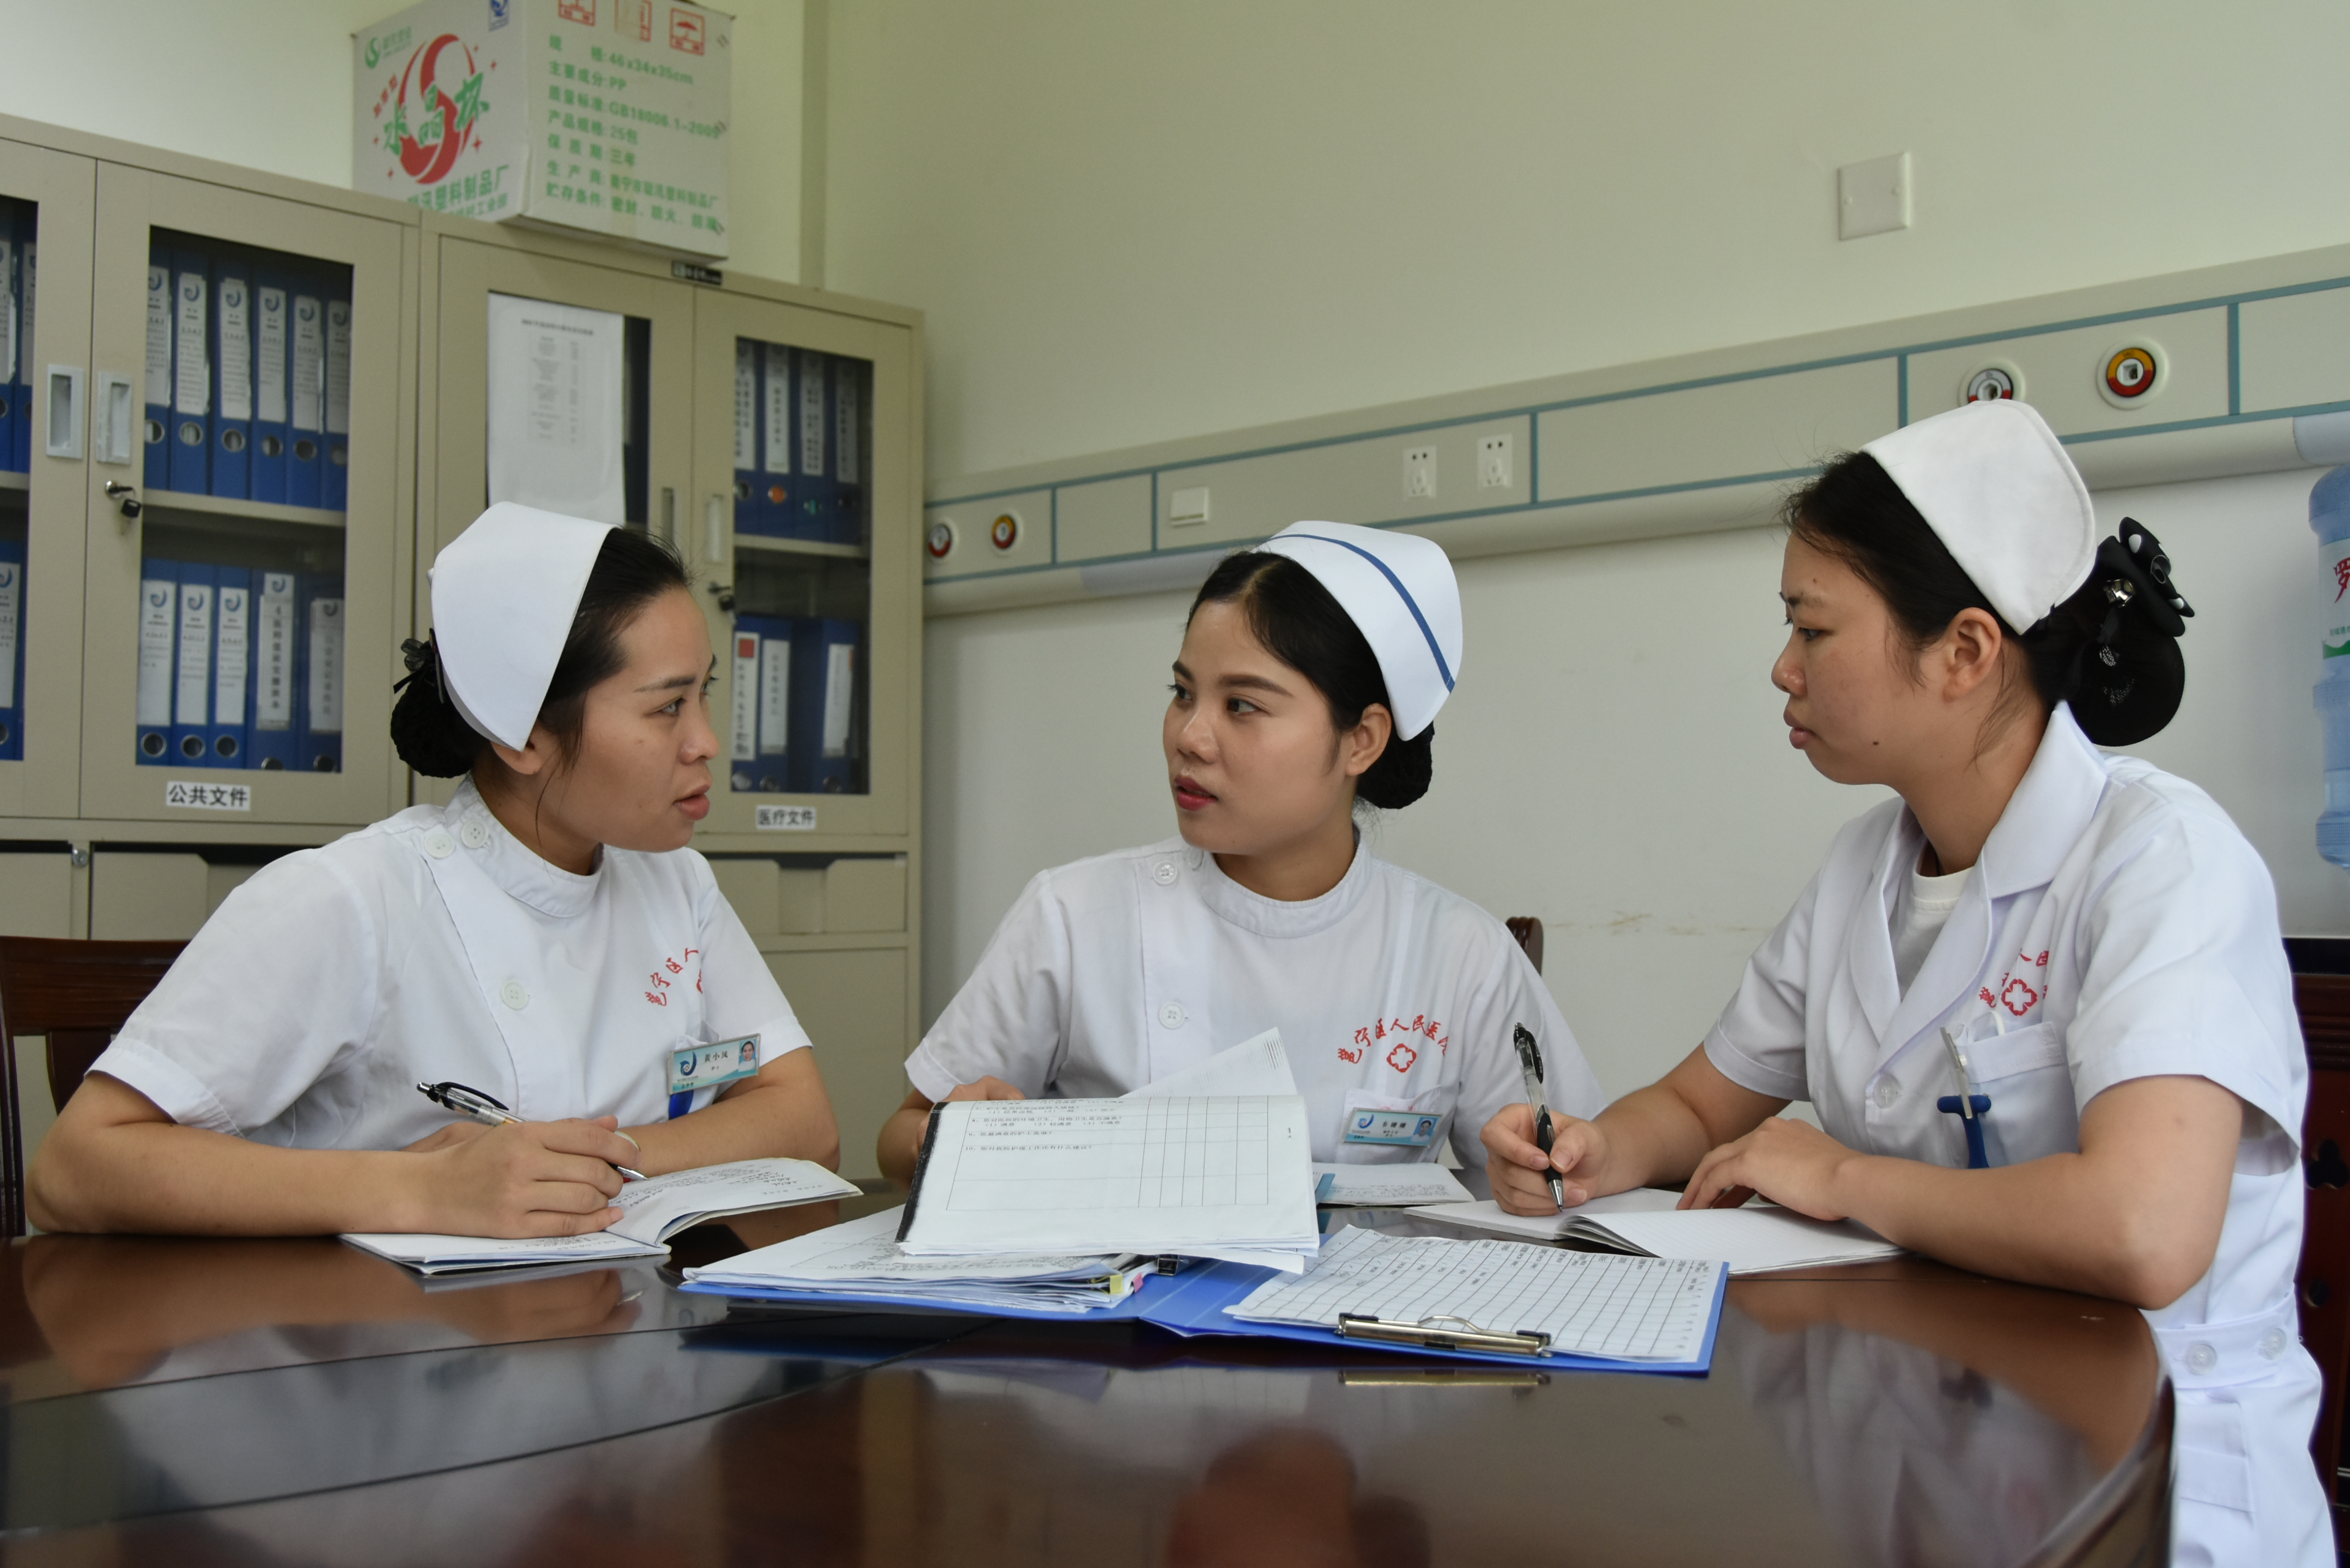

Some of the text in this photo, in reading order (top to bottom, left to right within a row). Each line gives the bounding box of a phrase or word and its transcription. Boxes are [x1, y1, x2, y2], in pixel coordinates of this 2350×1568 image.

[169, 785, 247, 807] 公共文件
[758, 809, 812, 825] 医疗文件
